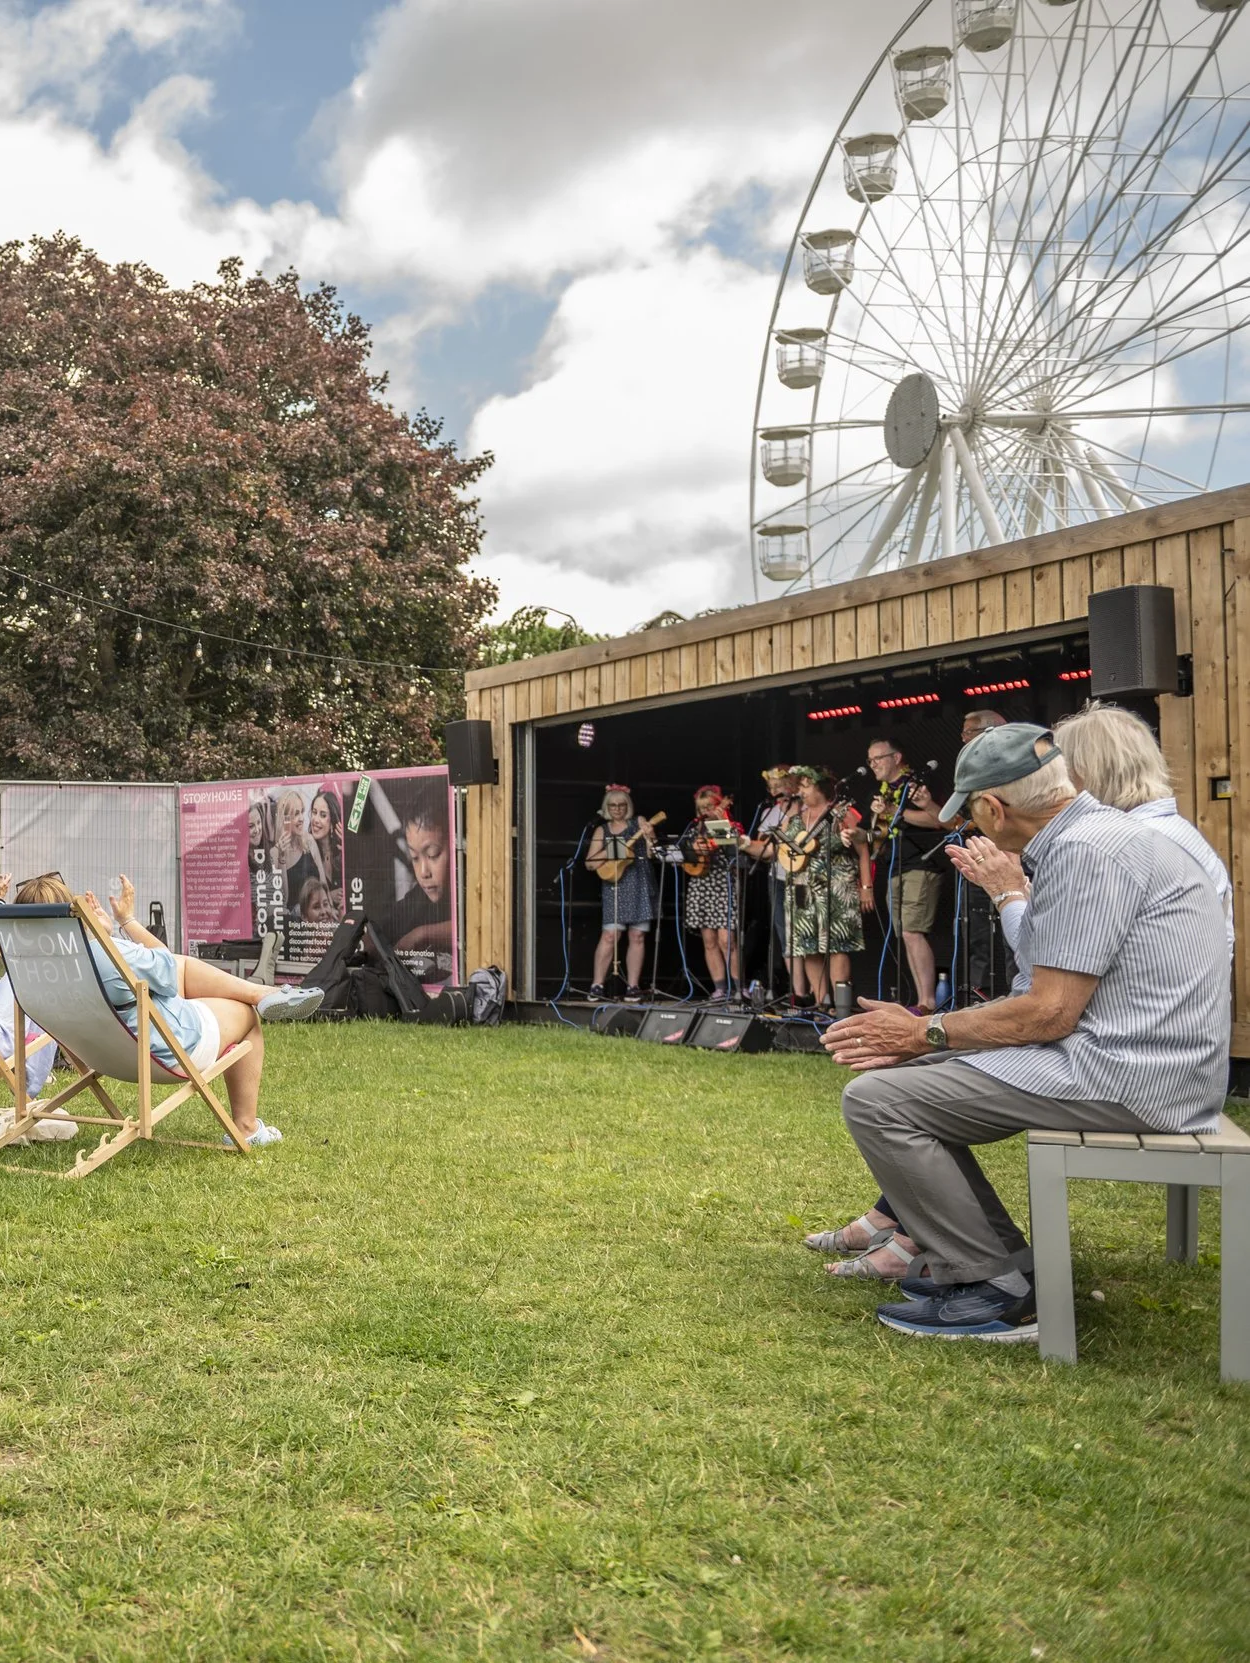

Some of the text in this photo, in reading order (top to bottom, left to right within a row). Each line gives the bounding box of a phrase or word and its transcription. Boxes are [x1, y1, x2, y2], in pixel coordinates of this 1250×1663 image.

[183, 789, 242, 804] STORYHOUSE
[253, 848, 268, 938] come a
[409, 949, 434, 957] donation
